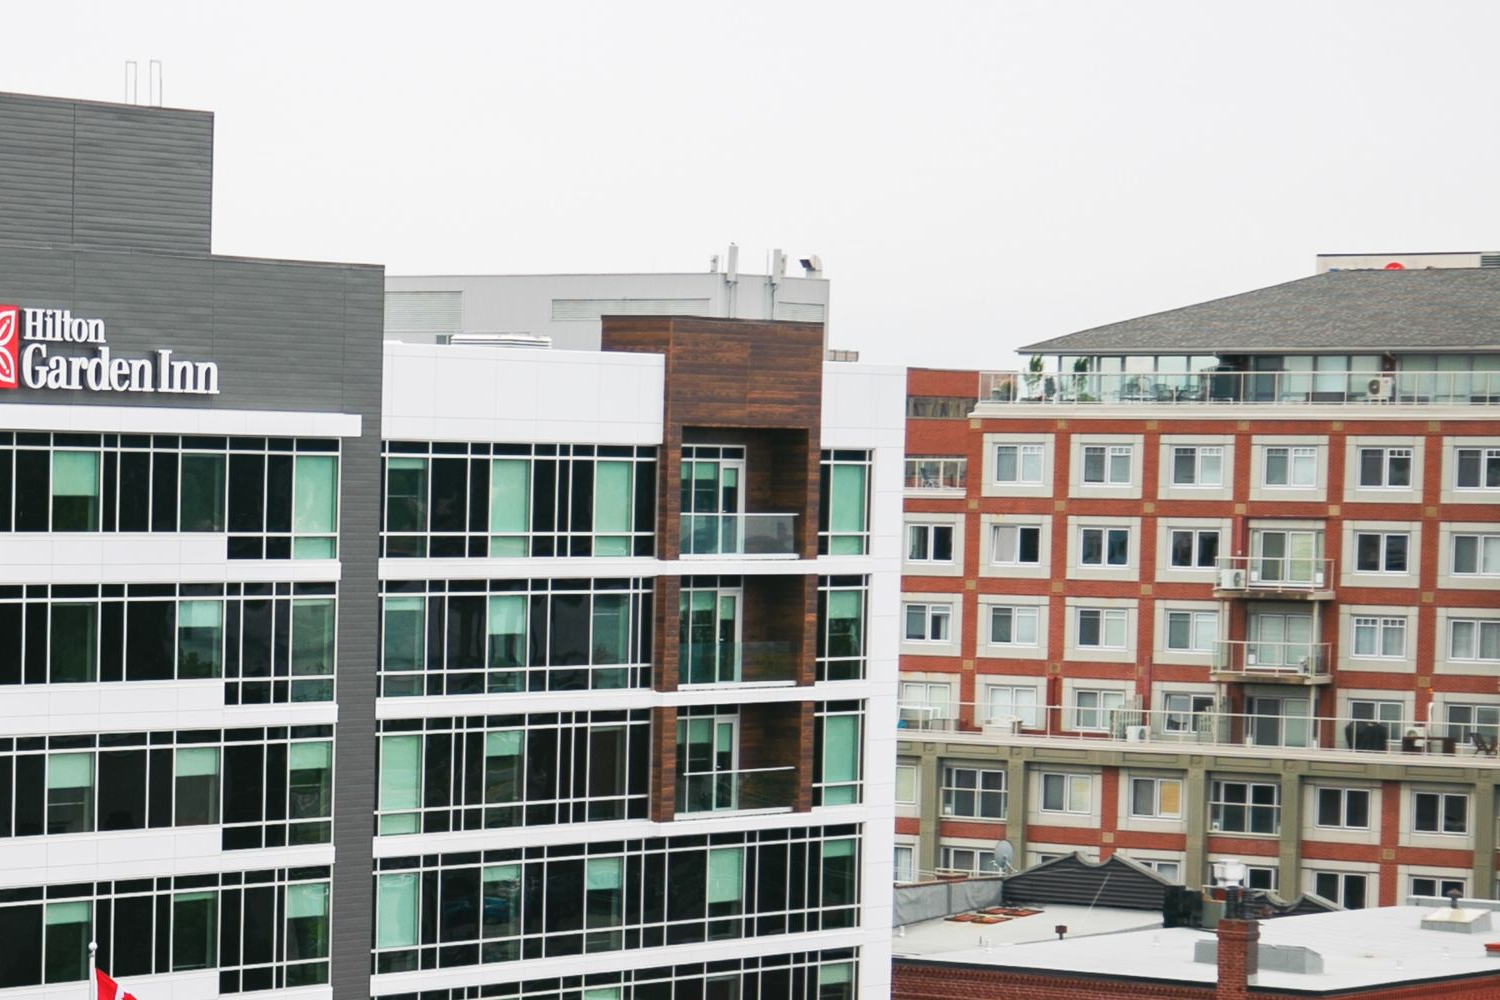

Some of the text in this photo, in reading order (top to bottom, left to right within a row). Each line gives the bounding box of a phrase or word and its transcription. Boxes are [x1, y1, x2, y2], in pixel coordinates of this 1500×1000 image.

[22, 307, 107, 344] Hilton
[21, 343, 220, 394] Garden Inn
